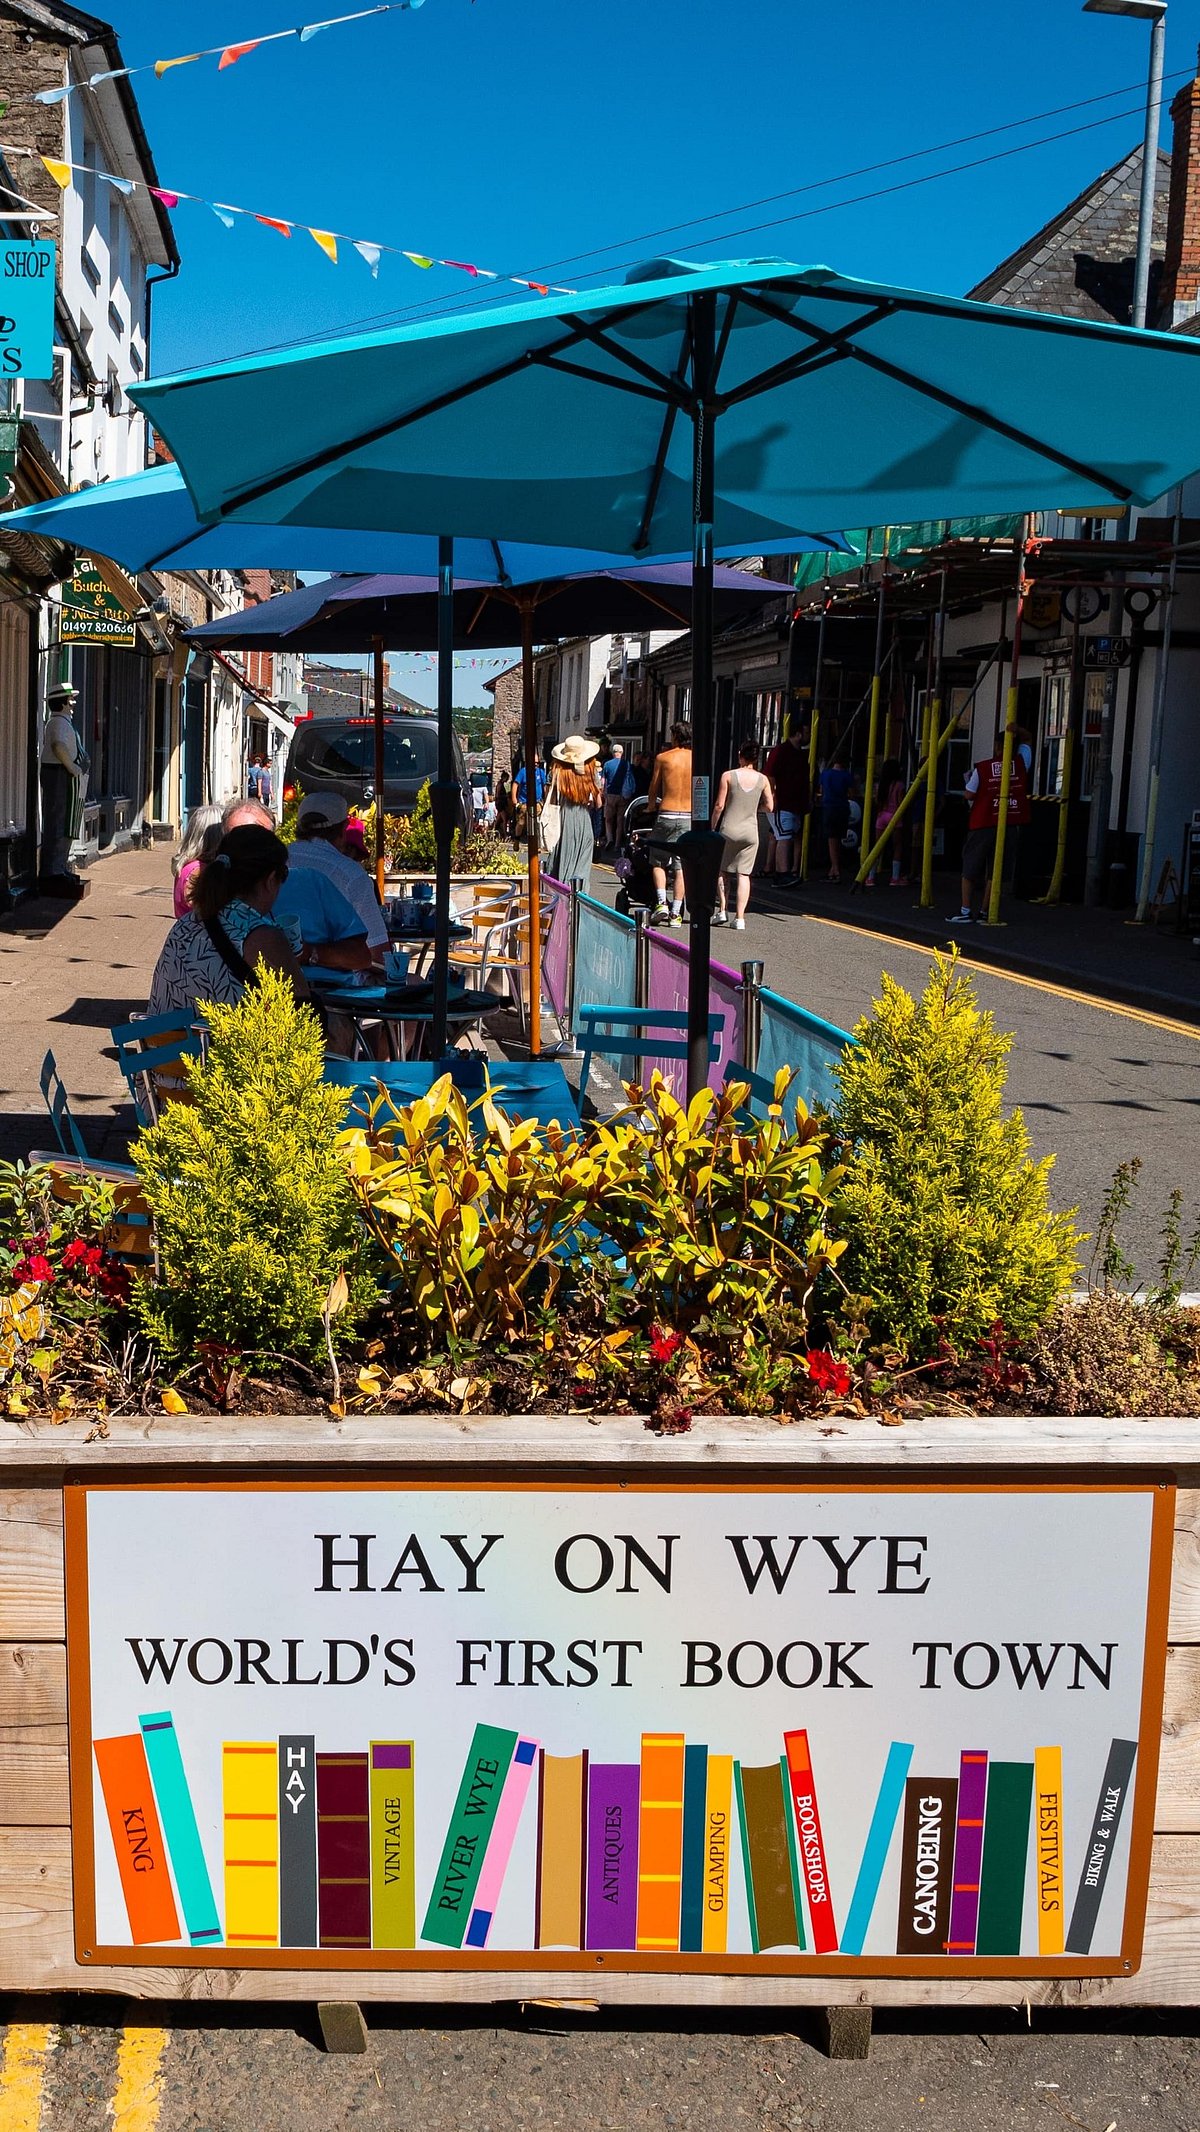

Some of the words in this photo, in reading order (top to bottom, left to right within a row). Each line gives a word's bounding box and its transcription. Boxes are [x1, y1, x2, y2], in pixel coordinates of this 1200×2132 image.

[4, 250, 51, 278] SHOP
[62, 621, 93, 633] 01497
[94, 593, 106, 606] &
[313, 1533, 505, 1592] HAY
[554, 1533, 681, 1593] ON
[724, 1535, 932, 1595] WYE
[124, 1633, 416, 1687] WORLD'S
[456, 1639, 643, 1688] FIRST
[679, 1640, 874, 1689] BOOK
[912, 1641, 1119, 1690] TOWN
[285, 1747, 307, 1814] HAY
[1100, 1786, 1121, 1822] WALK
[121, 1806, 155, 1873] KING
[384, 1797, 401, 1886] VINTAGE
[437, 1834, 479, 1913] RIVER
[464, 1758, 499, 1816] WYE
[602, 1805, 624, 1905] ANTIQUES
[708, 1811, 726, 1912] GLAMPING
[797, 1794, 827, 1904] BOOKSHOPS
[912, 1795, 943, 1935] CANOEING
[1040, 1792, 1059, 1912] FESTIVALS
[1084, 1843, 1106, 1887] BIKING
[1097, 1828, 1111, 1839] &
